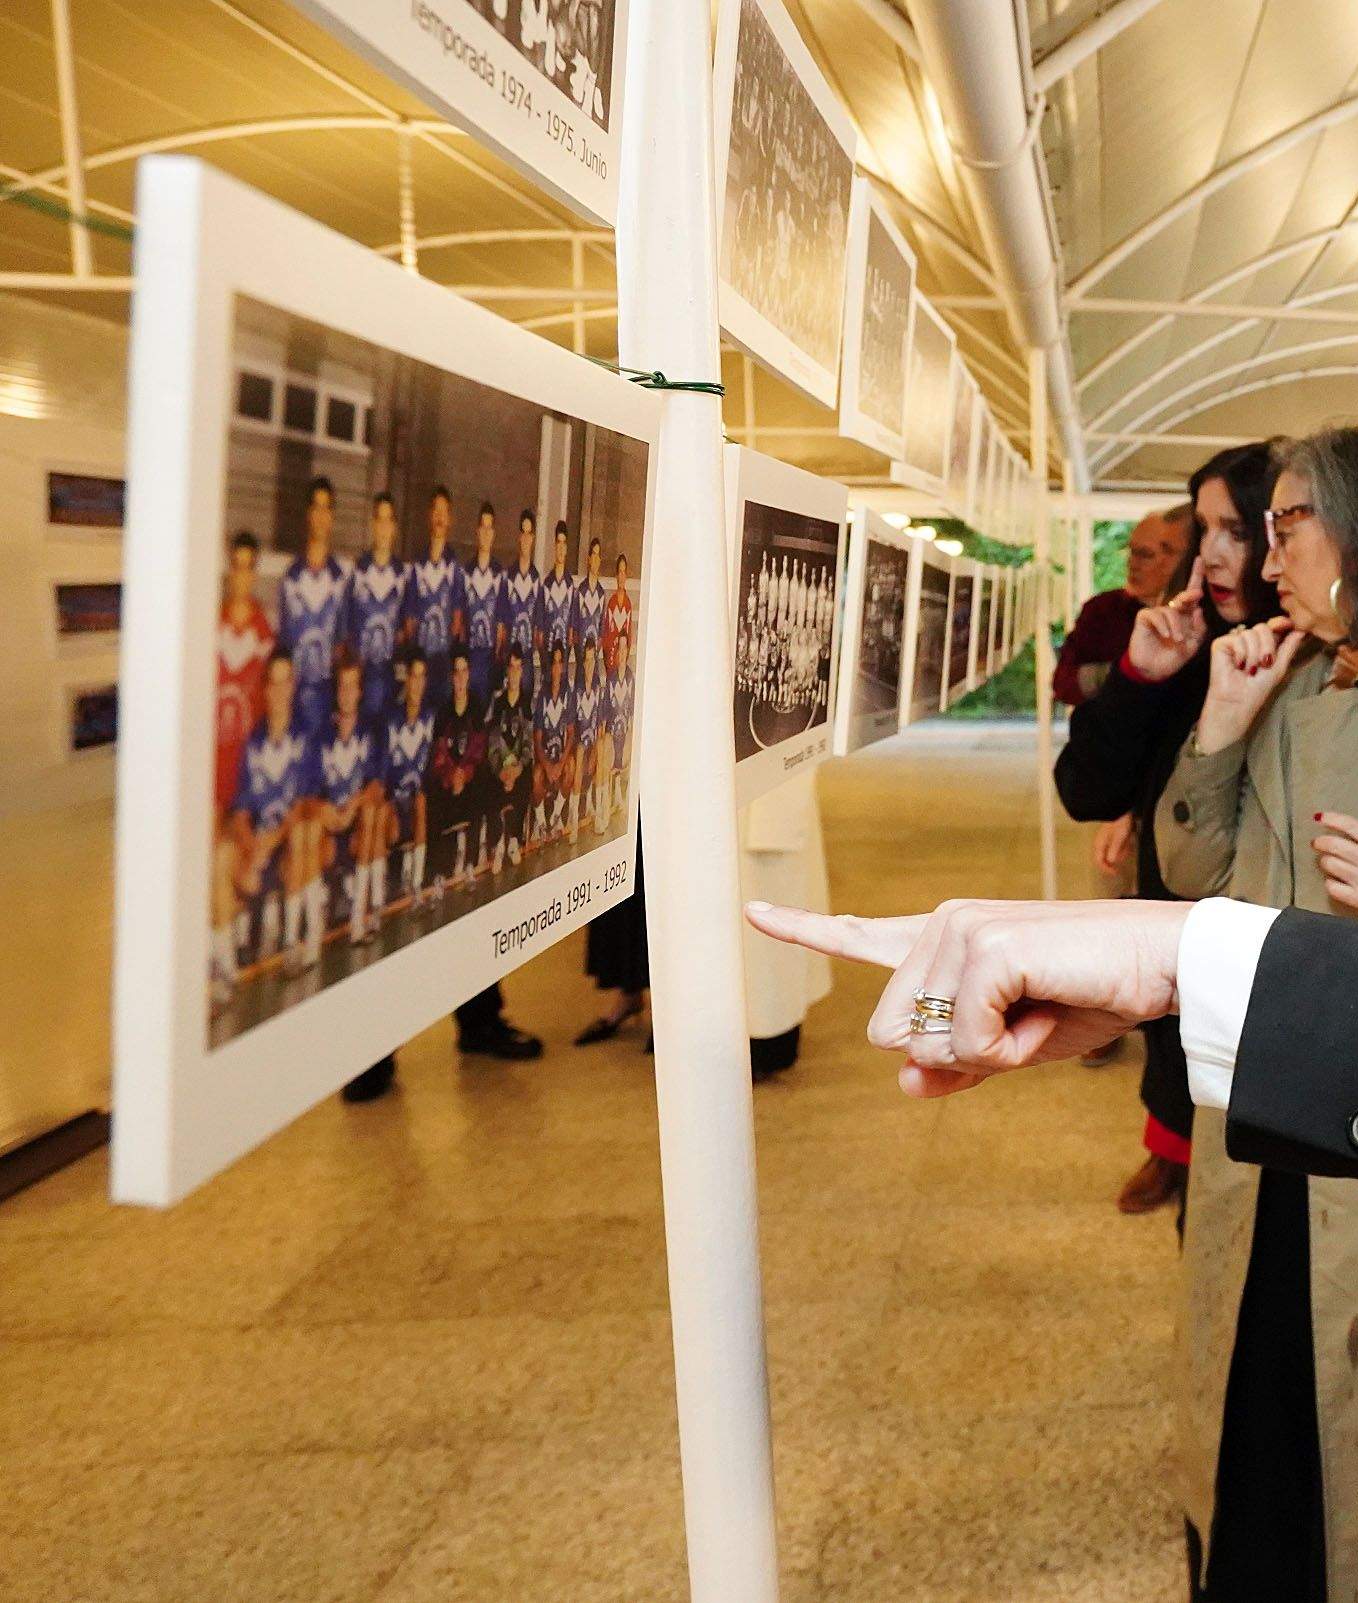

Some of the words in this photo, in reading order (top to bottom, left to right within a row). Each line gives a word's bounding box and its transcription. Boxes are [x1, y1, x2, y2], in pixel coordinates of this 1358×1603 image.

[501, 70, 533, 118] 1974
[546, 110, 577, 156] 1975.
[579, 137, 608, 180] Junio
[491, 898, 562, 959] Temporada
[566, 879, 592, 915] 1991
[603, 860, 627, 893] 1992
